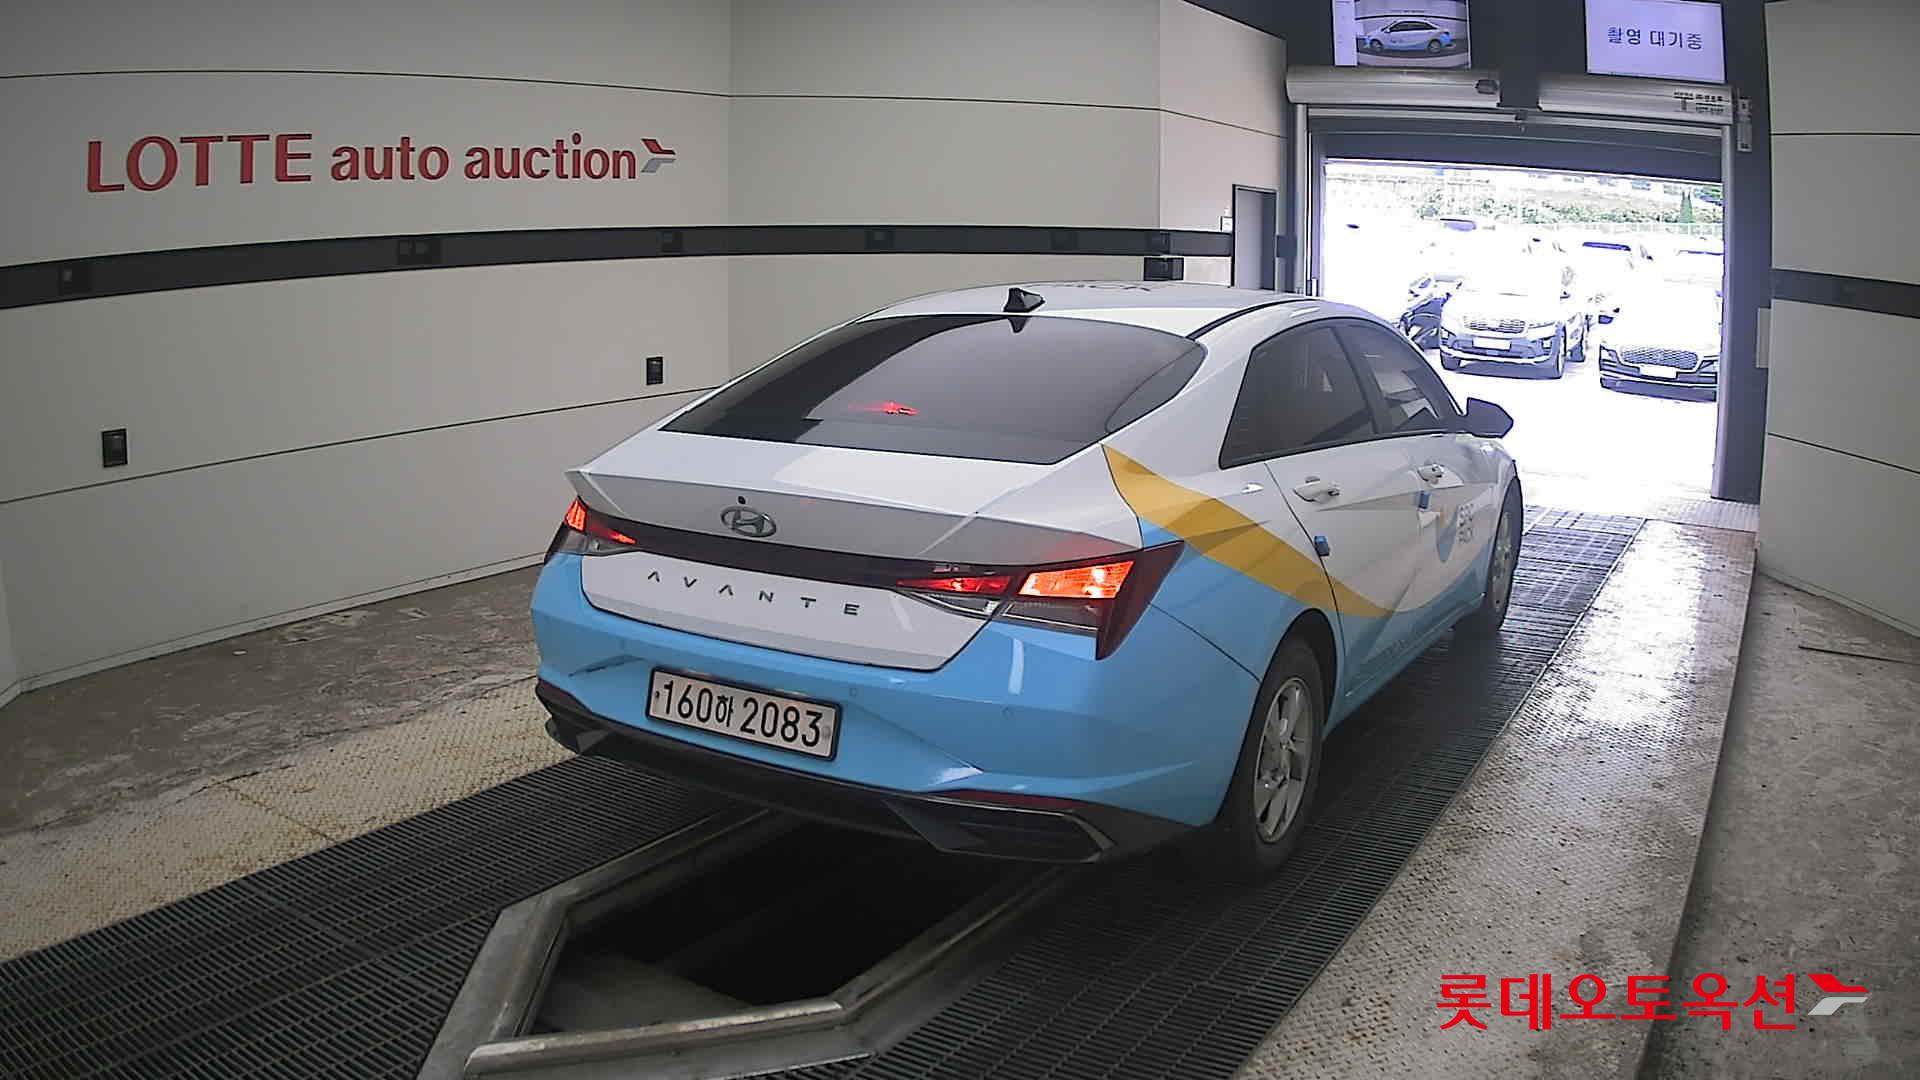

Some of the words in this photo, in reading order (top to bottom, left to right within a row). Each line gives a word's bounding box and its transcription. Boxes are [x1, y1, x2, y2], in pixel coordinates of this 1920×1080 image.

[1649, 30, 1703, 50] 대기중
[86, 133, 313, 194] LOTTE
[330, 136, 450, 182] auto
[463, 132, 637, 181] auction
[647, 570, 860, 617] AVANTE
[662, 679, 735, 728] 160하
[740, 697, 823, 748] 2083
